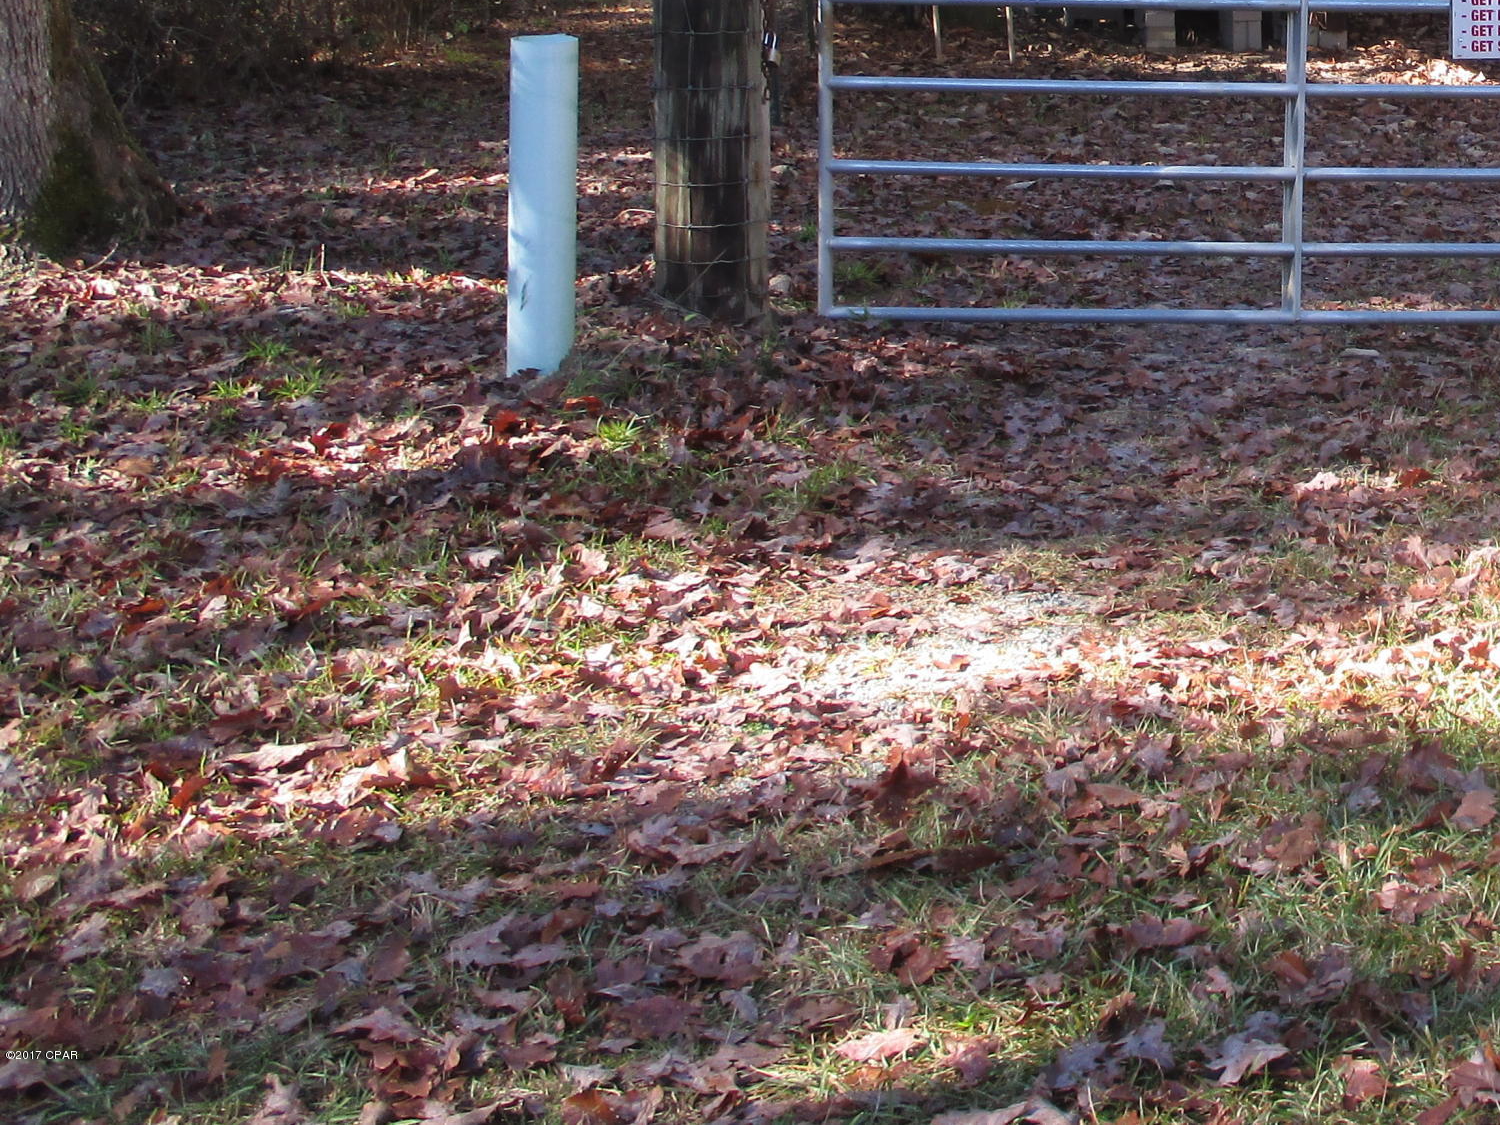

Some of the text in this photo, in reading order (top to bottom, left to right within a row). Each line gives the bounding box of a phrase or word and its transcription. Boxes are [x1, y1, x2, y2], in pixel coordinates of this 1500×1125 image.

[1471, 10, 1493, 21] GET
[1471, 25, 1493, 37] GET
[1471, 40, 1493, 52] GET
